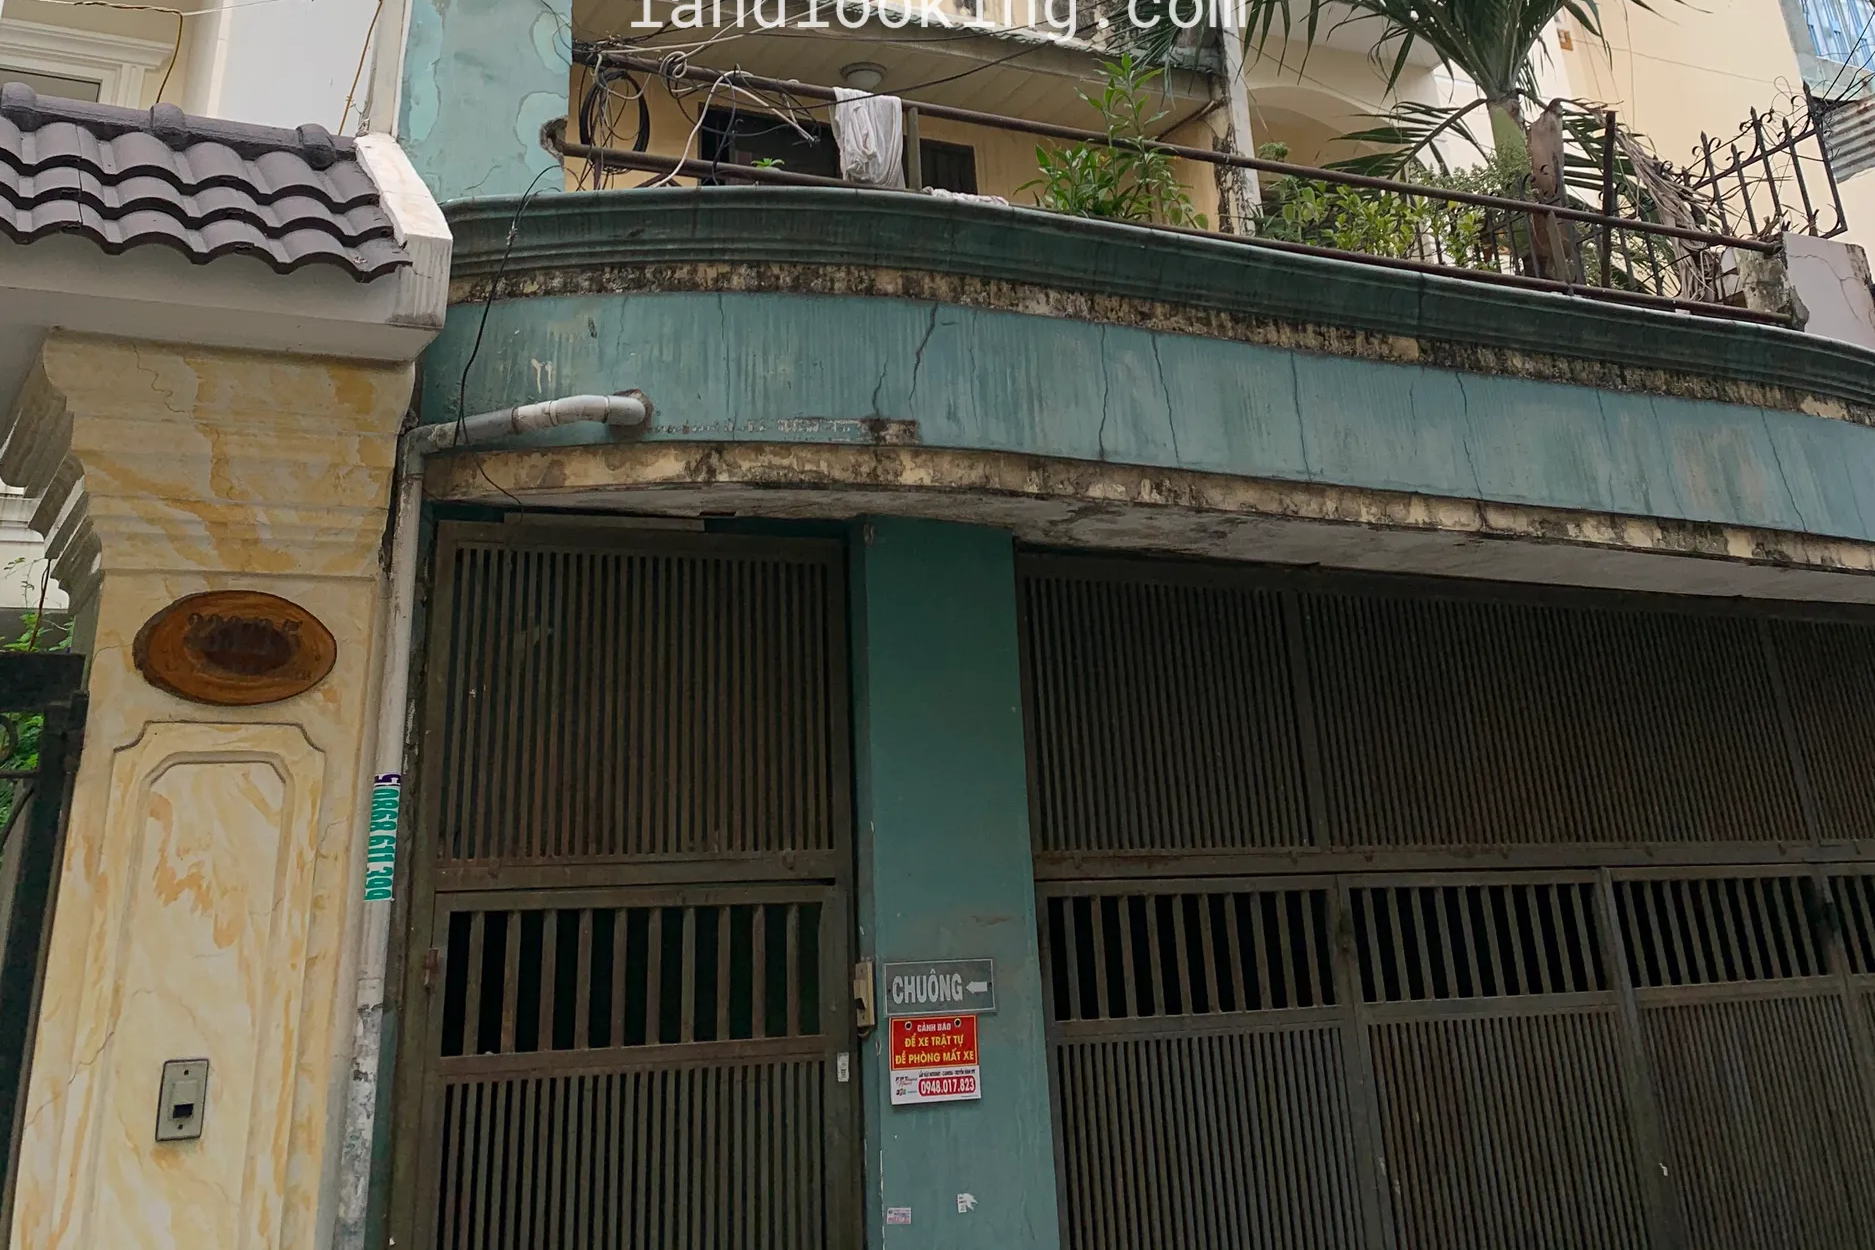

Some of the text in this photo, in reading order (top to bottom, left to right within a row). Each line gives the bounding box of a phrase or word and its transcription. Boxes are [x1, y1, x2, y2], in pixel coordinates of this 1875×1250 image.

[892, 968, 963, 1004] CHUÔNG
[918, 1037, 929, 1047] XE
[908, 1050, 941, 1064] PHÒNG
[943, 1047, 961, 1061] MẤT
[963, 1050, 975, 1061] XE
[920, 1077, 975, 1094] 0948.017.823
